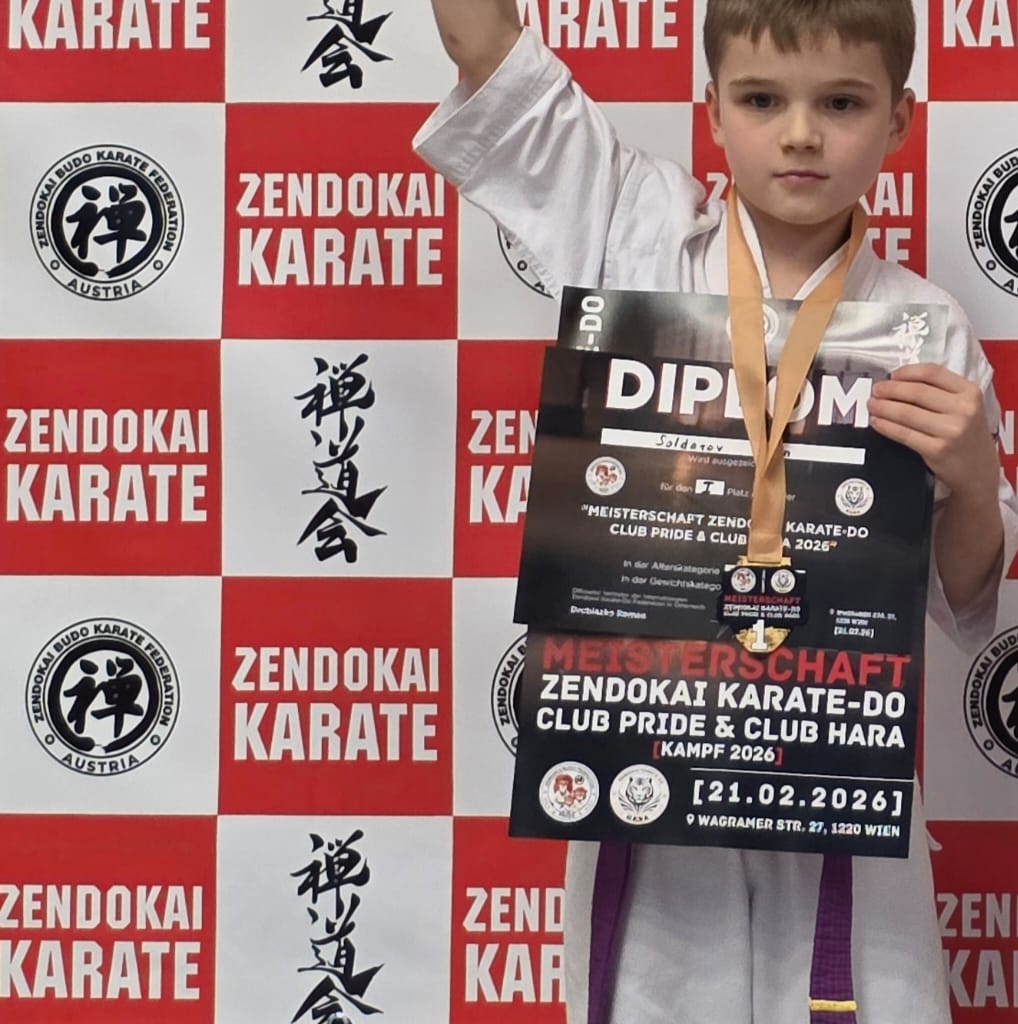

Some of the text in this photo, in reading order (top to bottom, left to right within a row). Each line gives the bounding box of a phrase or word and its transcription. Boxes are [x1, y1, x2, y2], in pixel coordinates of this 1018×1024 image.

[236, 172, 445, 216] ZENDOKAI
[238, 228, 442, 285] KARATE
[4, 409, 208, 453] ZENDOKAI
[7, 464, 207, 521] KARATE
[610, 523, 747, 545] CLUB PRIDE & CLUB
[786, 521, 869, 538] KARATE-DO
[752, 619, 768, 650] 1
[232, 647, 439, 691] ZENDOKAI
[544, 638, 911, 687] MEISTERSCHAFT
[540, 674, 905, 718] ZENDOKAI KARATE-DO
[234, 703, 437, 761] KARATE
[536, 707, 905, 748] CLUB PRIDE & CLUB HARA
[652, 740, 783, 765] [KAMPF 2026]
[693, 779, 903, 817] [21.02.2026]
[698, 814, 900, 837] WAGRAMER STR. 27, 1220 WIEN
[0, 885, 202, 930] ZENDOKAI
[0, 940, 200, 999] KARATE
